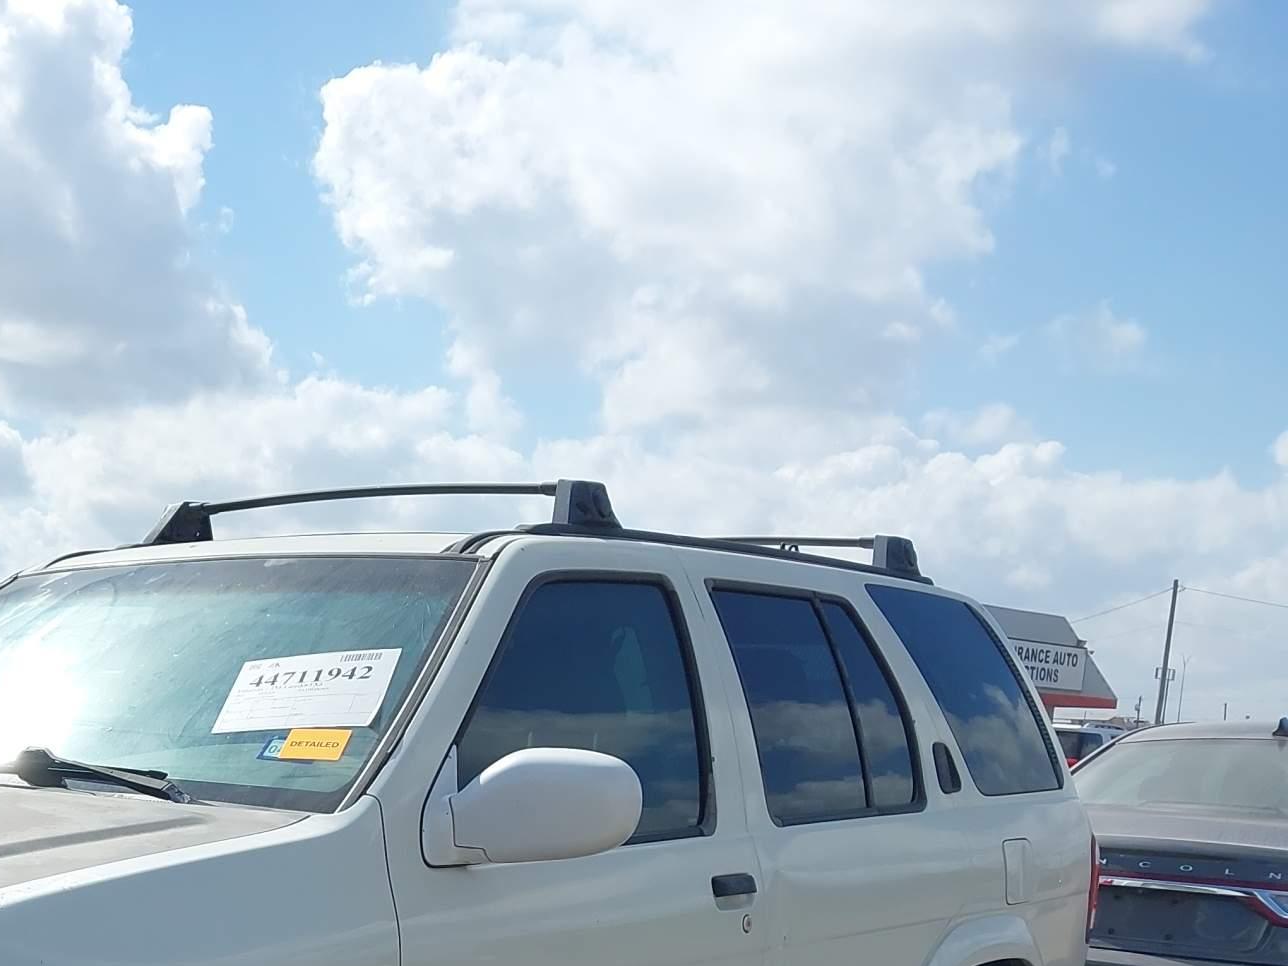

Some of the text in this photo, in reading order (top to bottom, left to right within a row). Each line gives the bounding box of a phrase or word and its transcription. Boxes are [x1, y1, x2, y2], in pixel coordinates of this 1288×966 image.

[1014, 645, 1078, 667] RANCE AUTO
[249, 666, 373, 688] 44711942
[1024, 665, 1059, 683] TIONS
[290, 741, 340, 749] DETAILED
